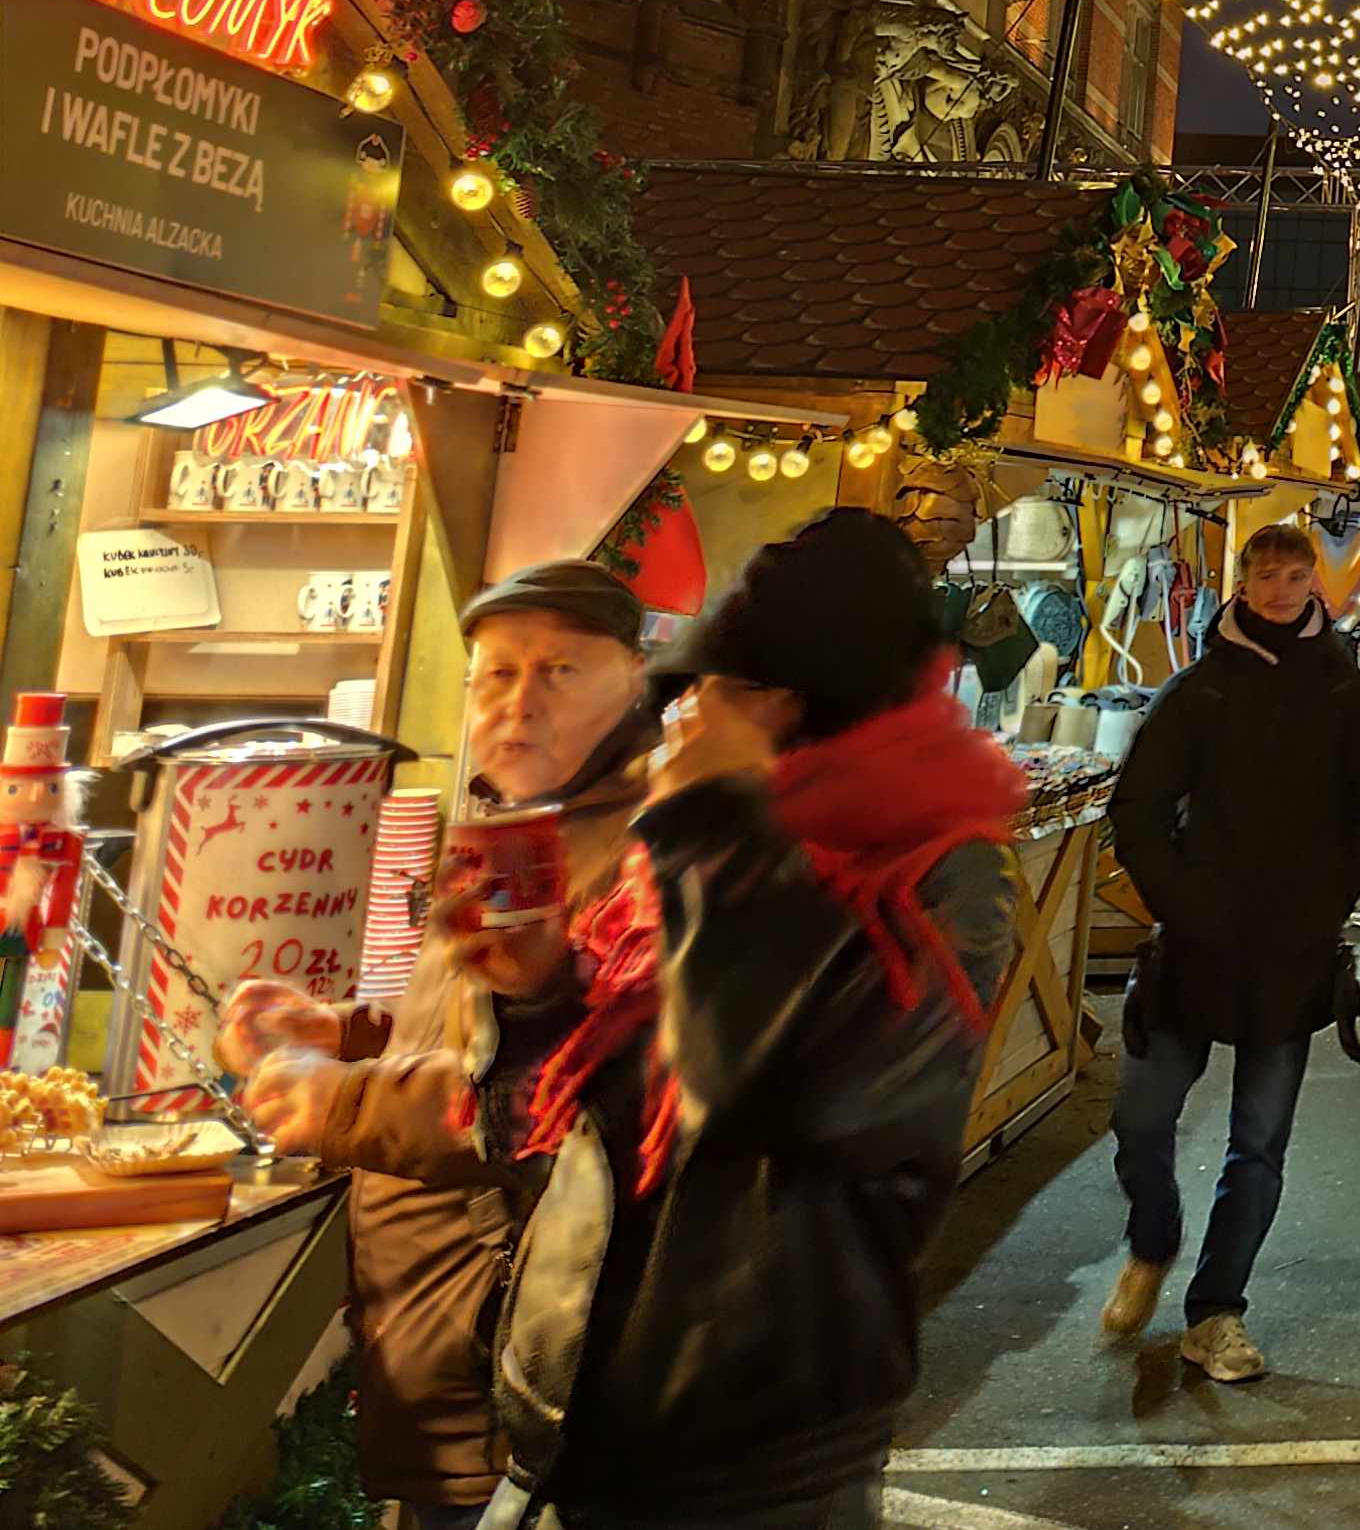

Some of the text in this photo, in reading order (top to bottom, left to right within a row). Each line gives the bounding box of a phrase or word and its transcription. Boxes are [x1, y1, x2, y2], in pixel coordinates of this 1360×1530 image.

[74, 27, 261, 136] PODPŁOMYKI
[41, 86, 265, 212] I WAFLE Z BEZĄ
[65, 191, 223, 260] KUCHNIA ALZACKA
[257, 848, 334, 873] CYDR
[206, 887, 358, 921] KORZENNY
